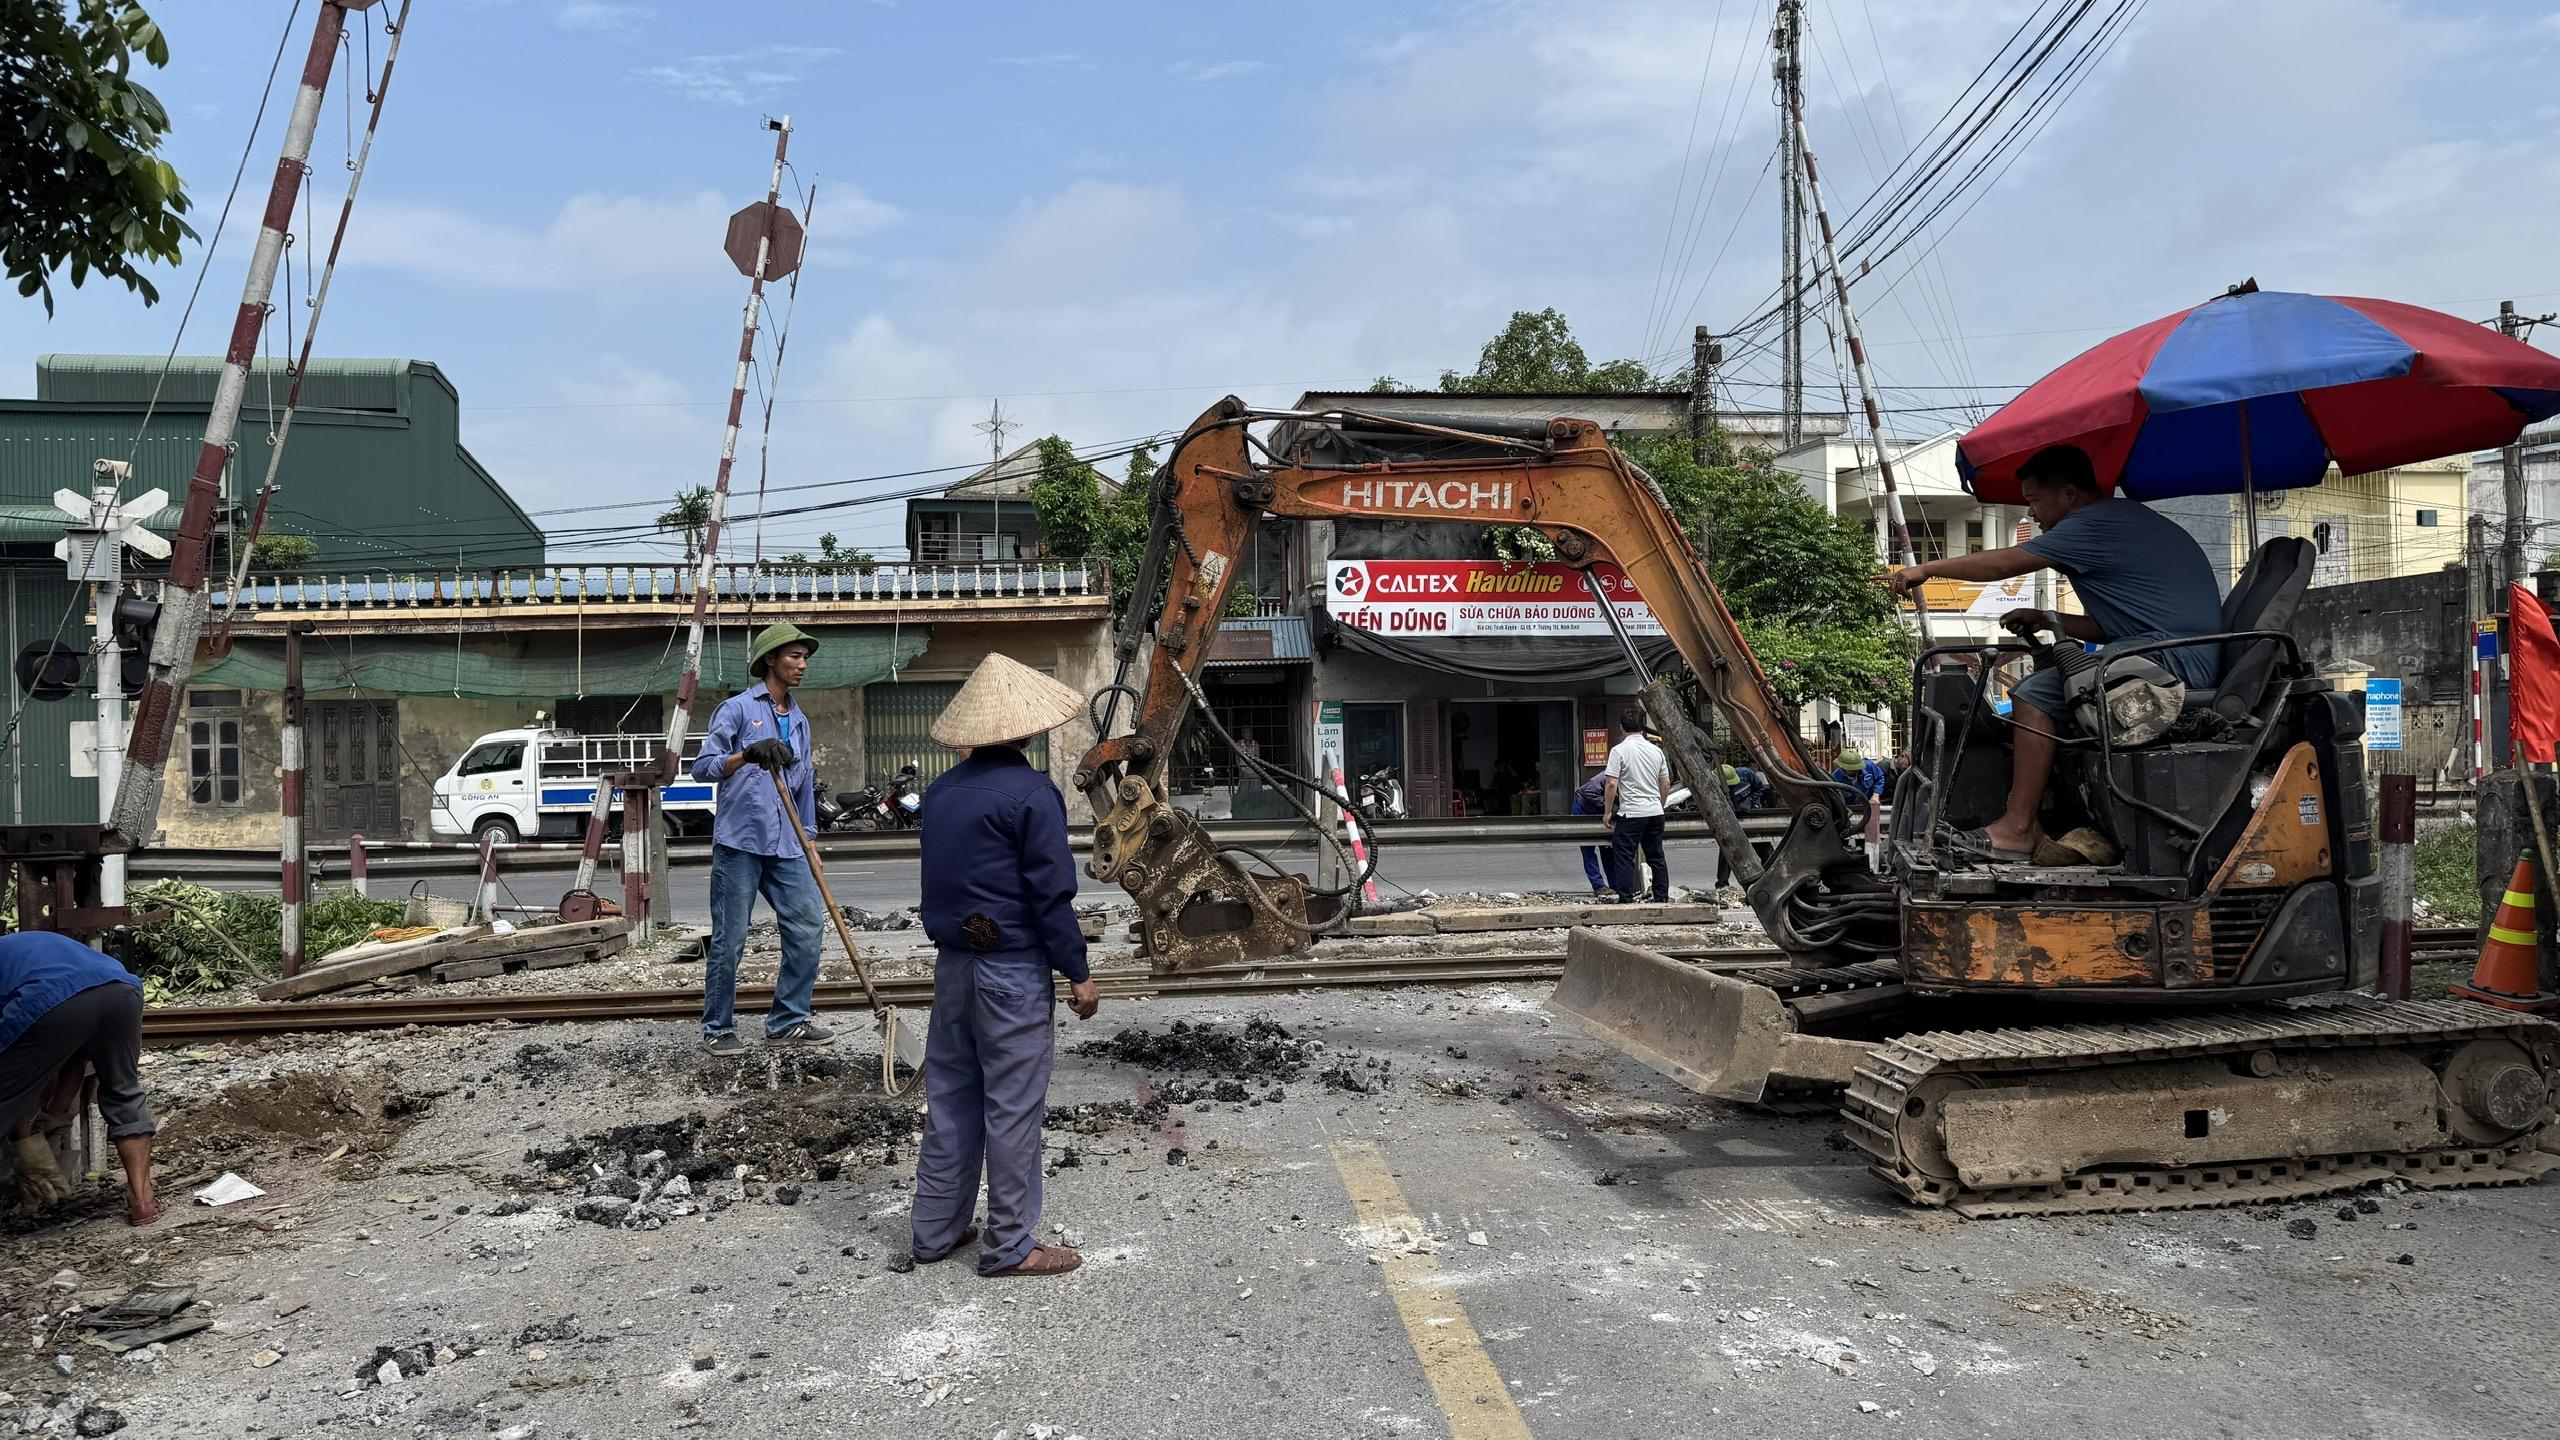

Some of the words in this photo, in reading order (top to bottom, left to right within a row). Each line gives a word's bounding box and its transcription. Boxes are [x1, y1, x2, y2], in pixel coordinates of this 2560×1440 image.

[1343, 480, 1513, 510] HITACHI
[1375, 574, 1459, 593] CALTEX
[1465, 570, 1564, 593] Havoline
[1337, 605, 1382, 631] TIẾN
[1390, 607, 1447, 631] DŨNG
[1459, 604, 1484, 619] SỬA
[1488, 605, 1521, 619] CHỮA
[1525, 604, 1548, 619] BẢO
[1553, 605, 1595, 619] DƯỠNG
[2367, 692, 2399, 702] naphone
